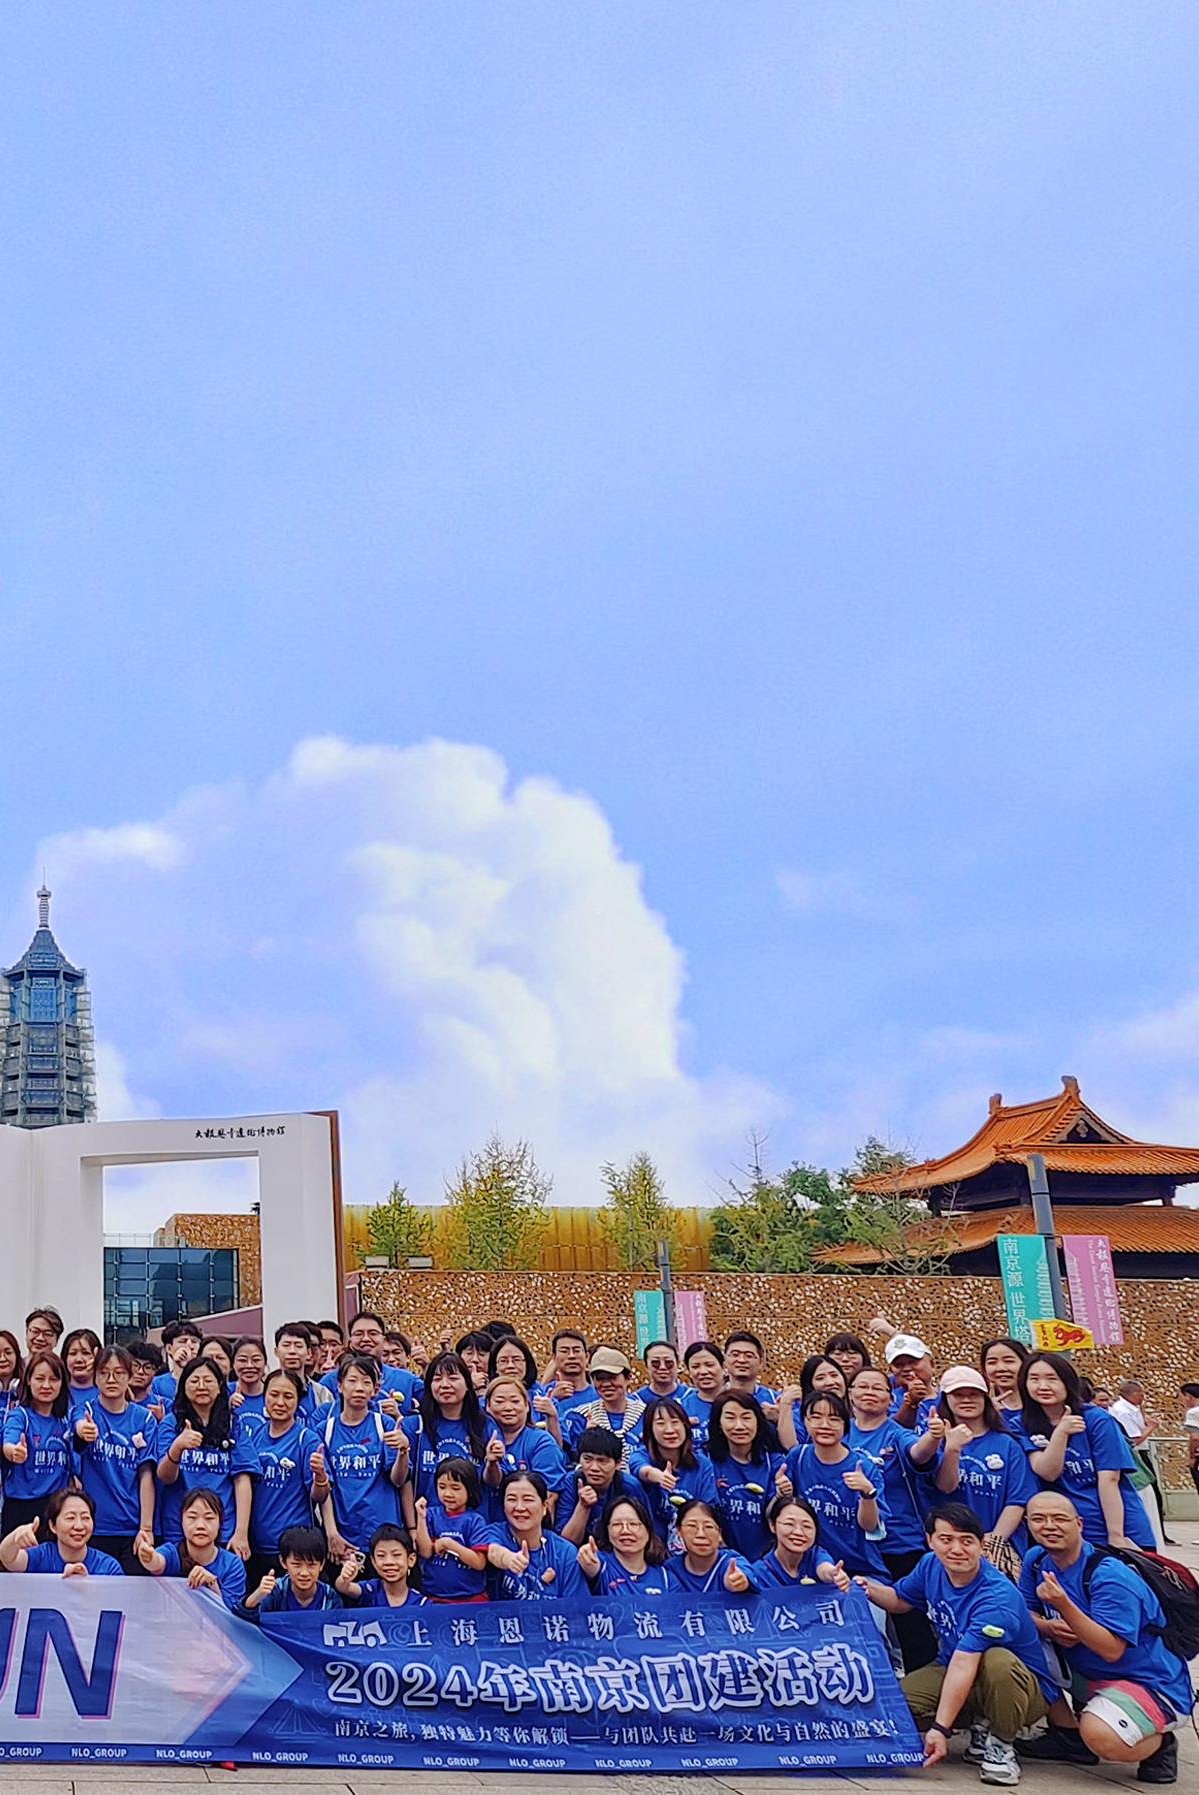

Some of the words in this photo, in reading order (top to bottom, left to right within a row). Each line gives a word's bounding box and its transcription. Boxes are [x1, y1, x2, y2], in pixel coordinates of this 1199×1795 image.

[1003, 1238, 1024, 1288] 南京源
[1010, 1291, 1031, 1341] 世界塔
[407, 1599, 845, 1647] 上海恩诺物流有限公司
[325, 1643, 874, 1714] 2024年南京团建活动
[71, 1747, 128, 1758] NLO_GROUP
[155, 1749, 213, 1760] NLO_GROUP
[252, 1752, 309, 1763] NLO_GROUP
[337, 1753, 395, 1765] NLO_GROUP
[423, 1756, 480, 1767] NLO_GROUP
[509, 1758, 566, 1769] NLO_GROUP
[595, 1758, 652, 1769] NLO_GROUP
[681, 1757, 739, 1768] NLO_GROUP
[779, 1755, 837, 1766] NLO_GROUP
